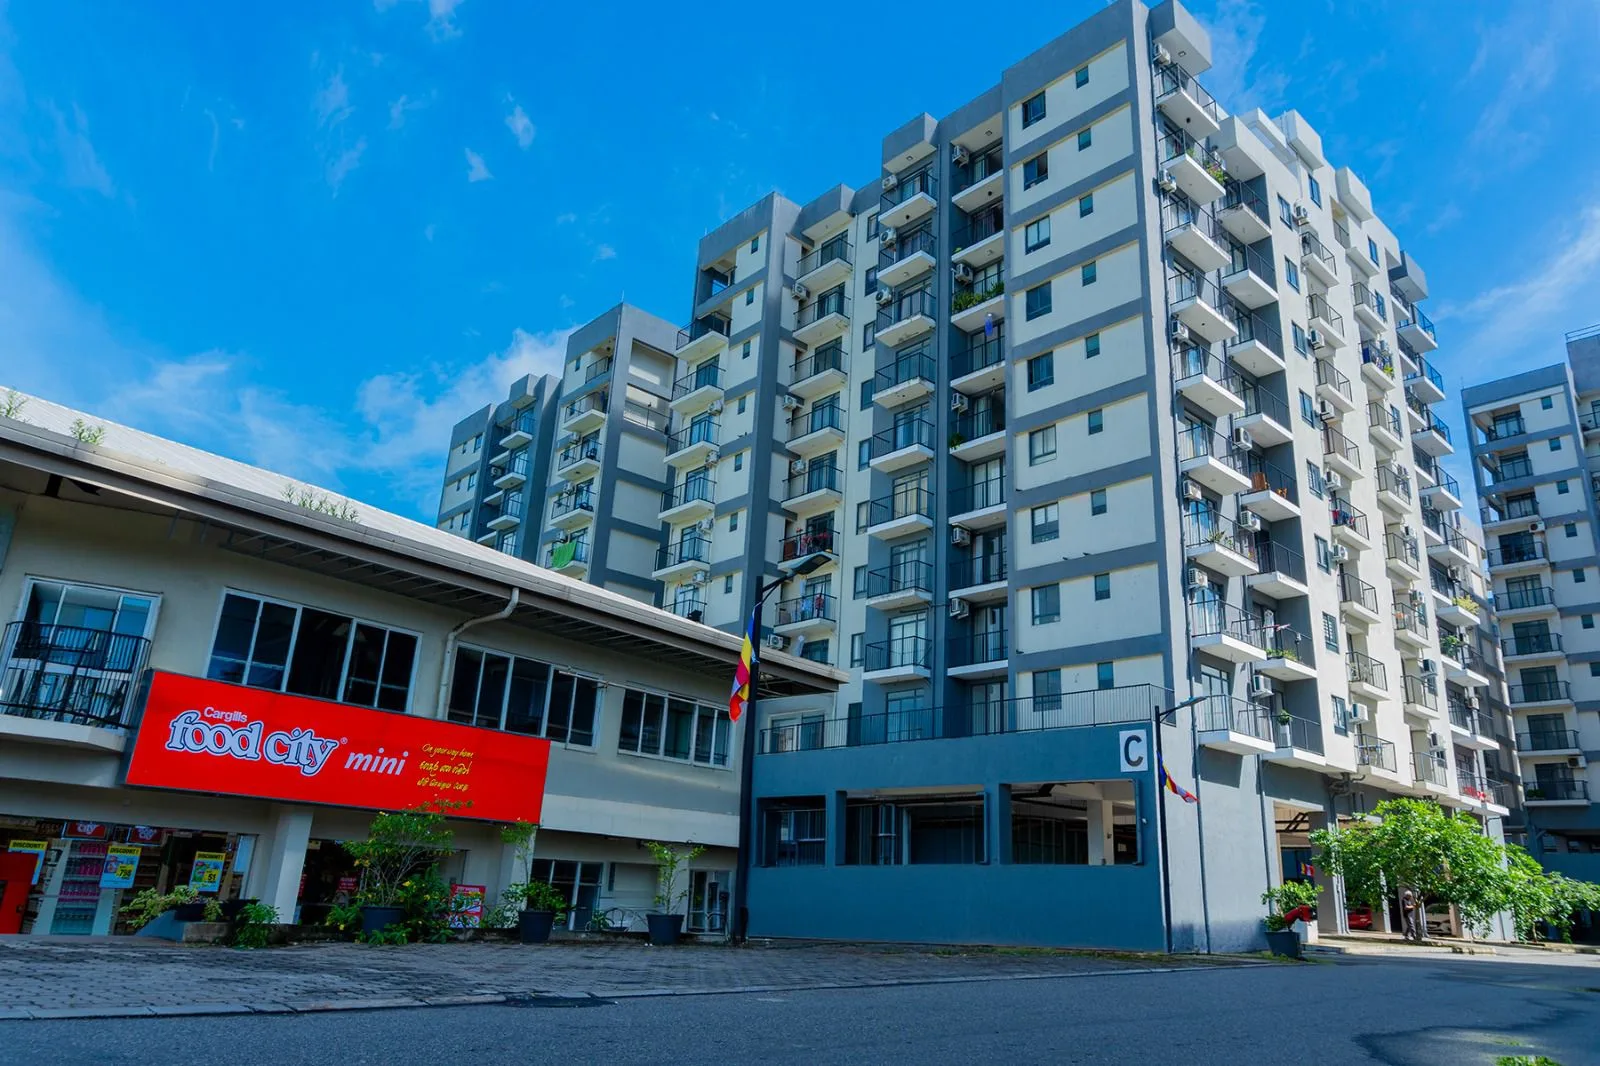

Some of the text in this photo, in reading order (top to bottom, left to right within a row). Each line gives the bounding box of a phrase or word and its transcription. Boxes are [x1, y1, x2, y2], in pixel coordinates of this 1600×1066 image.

[203, 706, 248, 722] Cargills
[165, 710, 409, 776] food city mini
[1124, 734, 1144, 767] C
